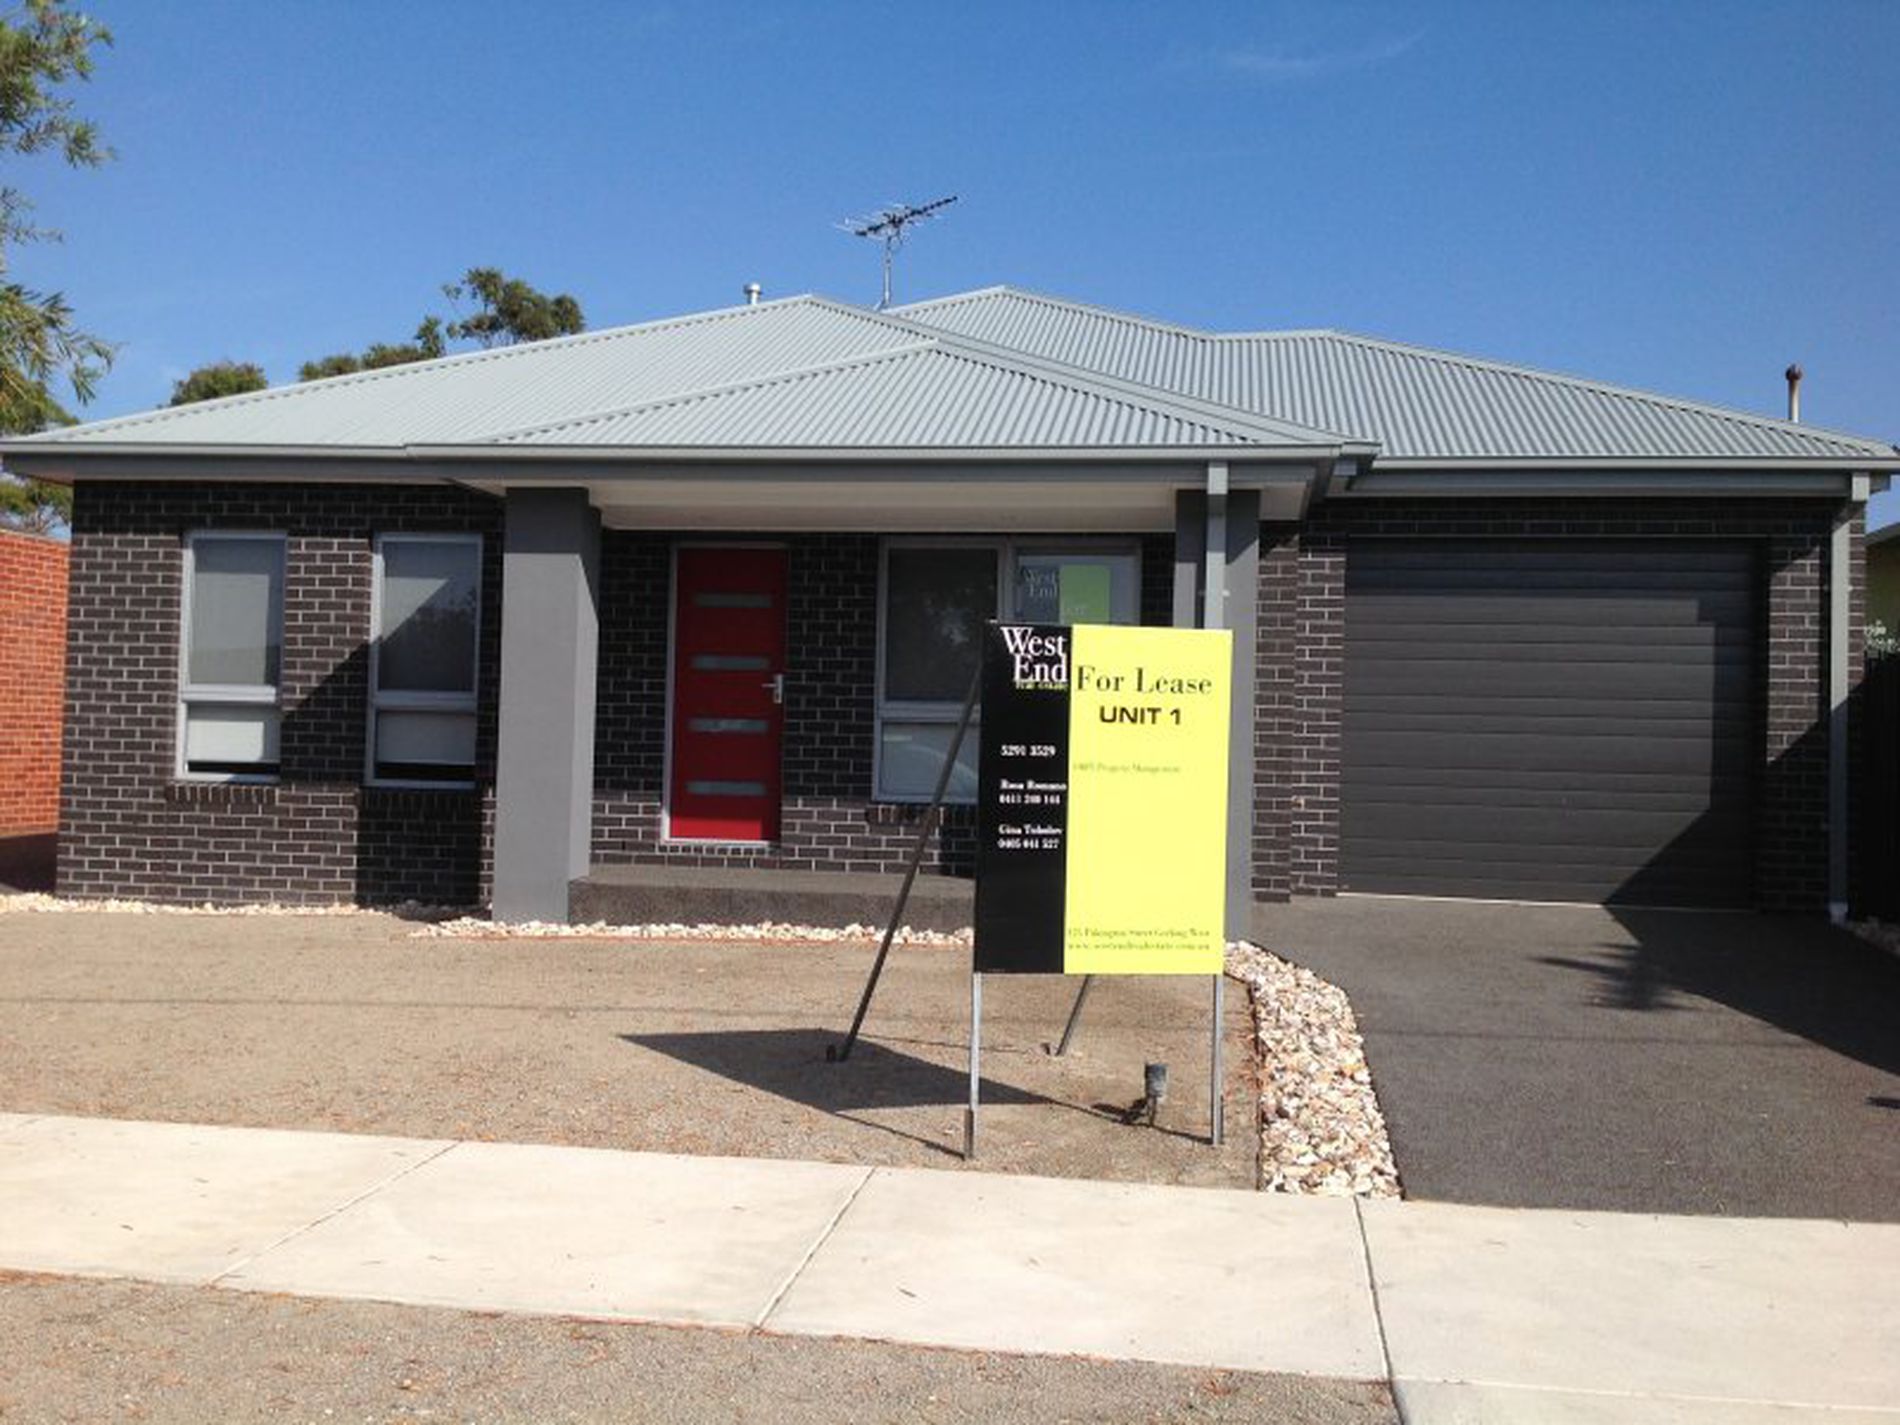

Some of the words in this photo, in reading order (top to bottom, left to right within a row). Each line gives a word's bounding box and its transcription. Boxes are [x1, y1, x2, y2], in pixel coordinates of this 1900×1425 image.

[1000, 626, 1067, 657] West
[1013, 654, 1068, 682] End
[1077, 665, 1125, 692] For
[1136, 667, 1213, 695] Lease
[1099, 706, 1162, 725] UNIT
[1170, 708, 1182, 726] 1
